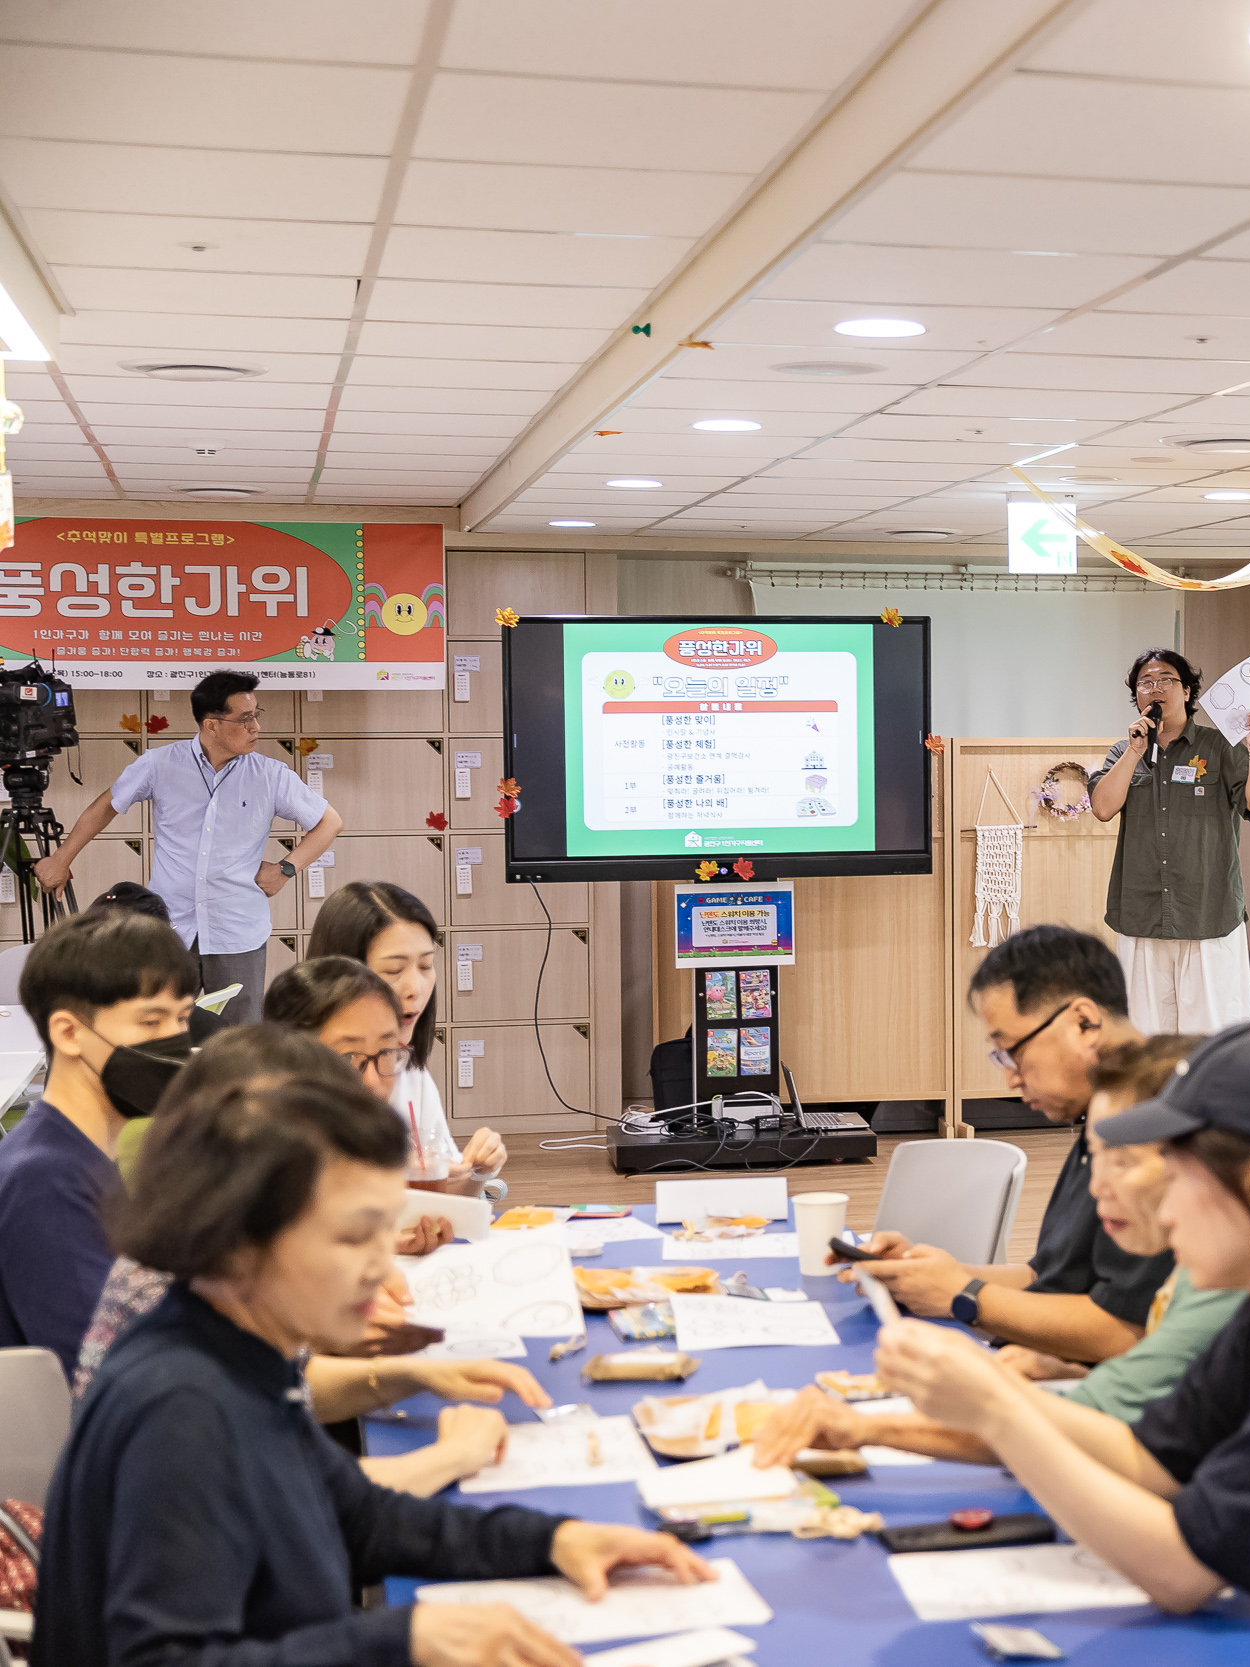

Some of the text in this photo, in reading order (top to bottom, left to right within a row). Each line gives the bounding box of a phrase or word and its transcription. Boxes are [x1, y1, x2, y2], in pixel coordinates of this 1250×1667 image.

[56, 531, 236, 546] <추석맞이 특별프로그램>
[0, 560, 309, 619] 풍성한가위
[33, 629, 90, 641] 1인가구가
[98, 630, 123, 641] 함께
[128, 630, 152, 641] 모여
[239, 631, 263, 642] 시간
[678, 638, 763, 657] 풍성한가위
[147, 670, 163, 678] 장소
[661, 714, 716, 726] [풍성한 맞이]
[662, 738, 716, 750] [풍성한 체험]
[662, 773, 725, 785] [풍성한 즐거움]
[663, 797, 728, 809] [풍성한 나의 배]
[743, 895, 764, 903] CAFE
